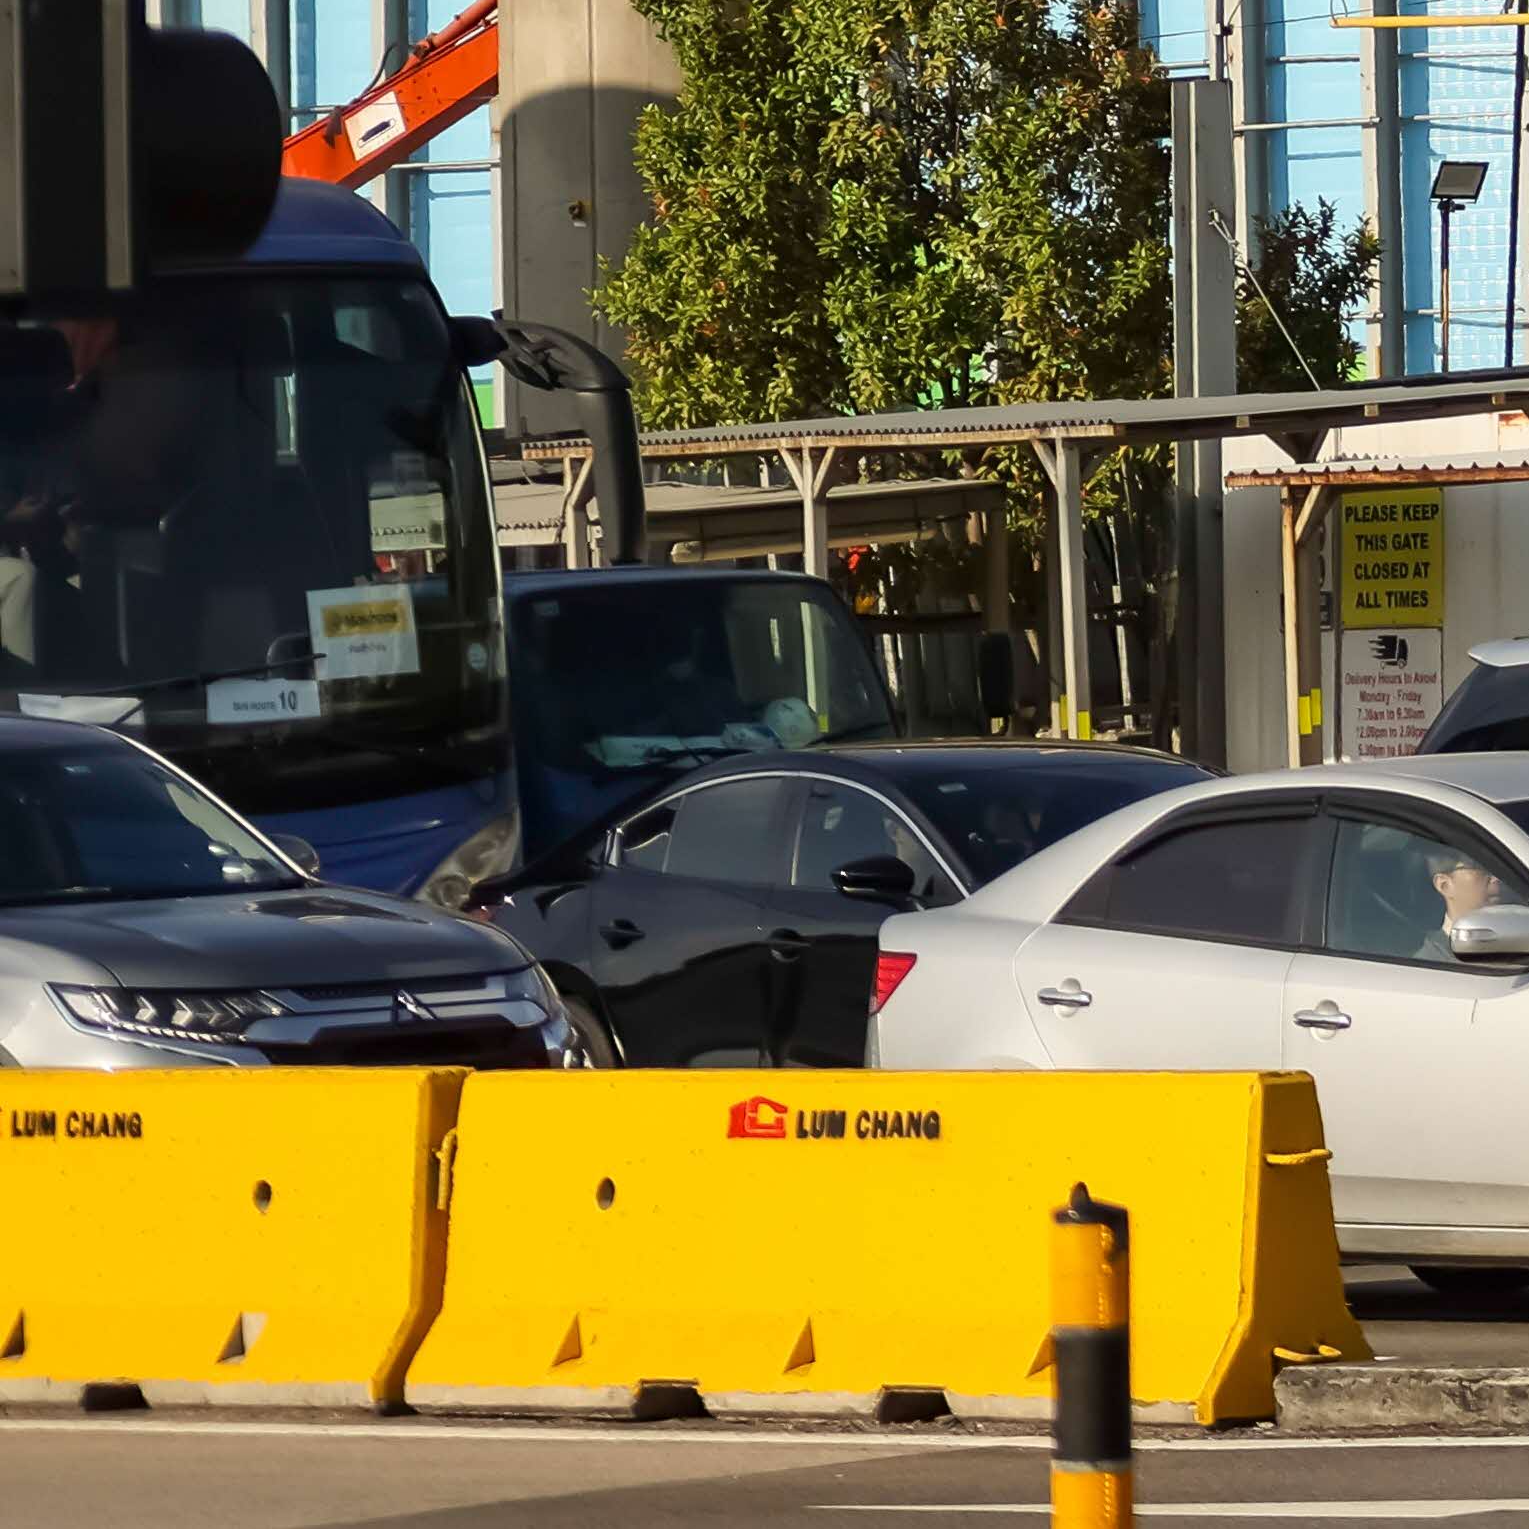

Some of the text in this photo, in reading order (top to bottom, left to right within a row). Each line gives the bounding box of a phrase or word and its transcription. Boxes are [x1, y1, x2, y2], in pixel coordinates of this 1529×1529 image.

[1345, 503, 1439, 523] PLEASE KEEP
[1355, 532, 1430, 552] THIS GATE
[1354, 561, 1431, 581] CLOSED AT
[1356, 590, 1429, 609] ALL TIMES
[279, 691, 298, 710] 10
[1359, 691, 1390, 705] Monday
[11, 1110, 143, 1138] LUM CHANG
[796, 1110, 941, 1140] LUM CHANG
